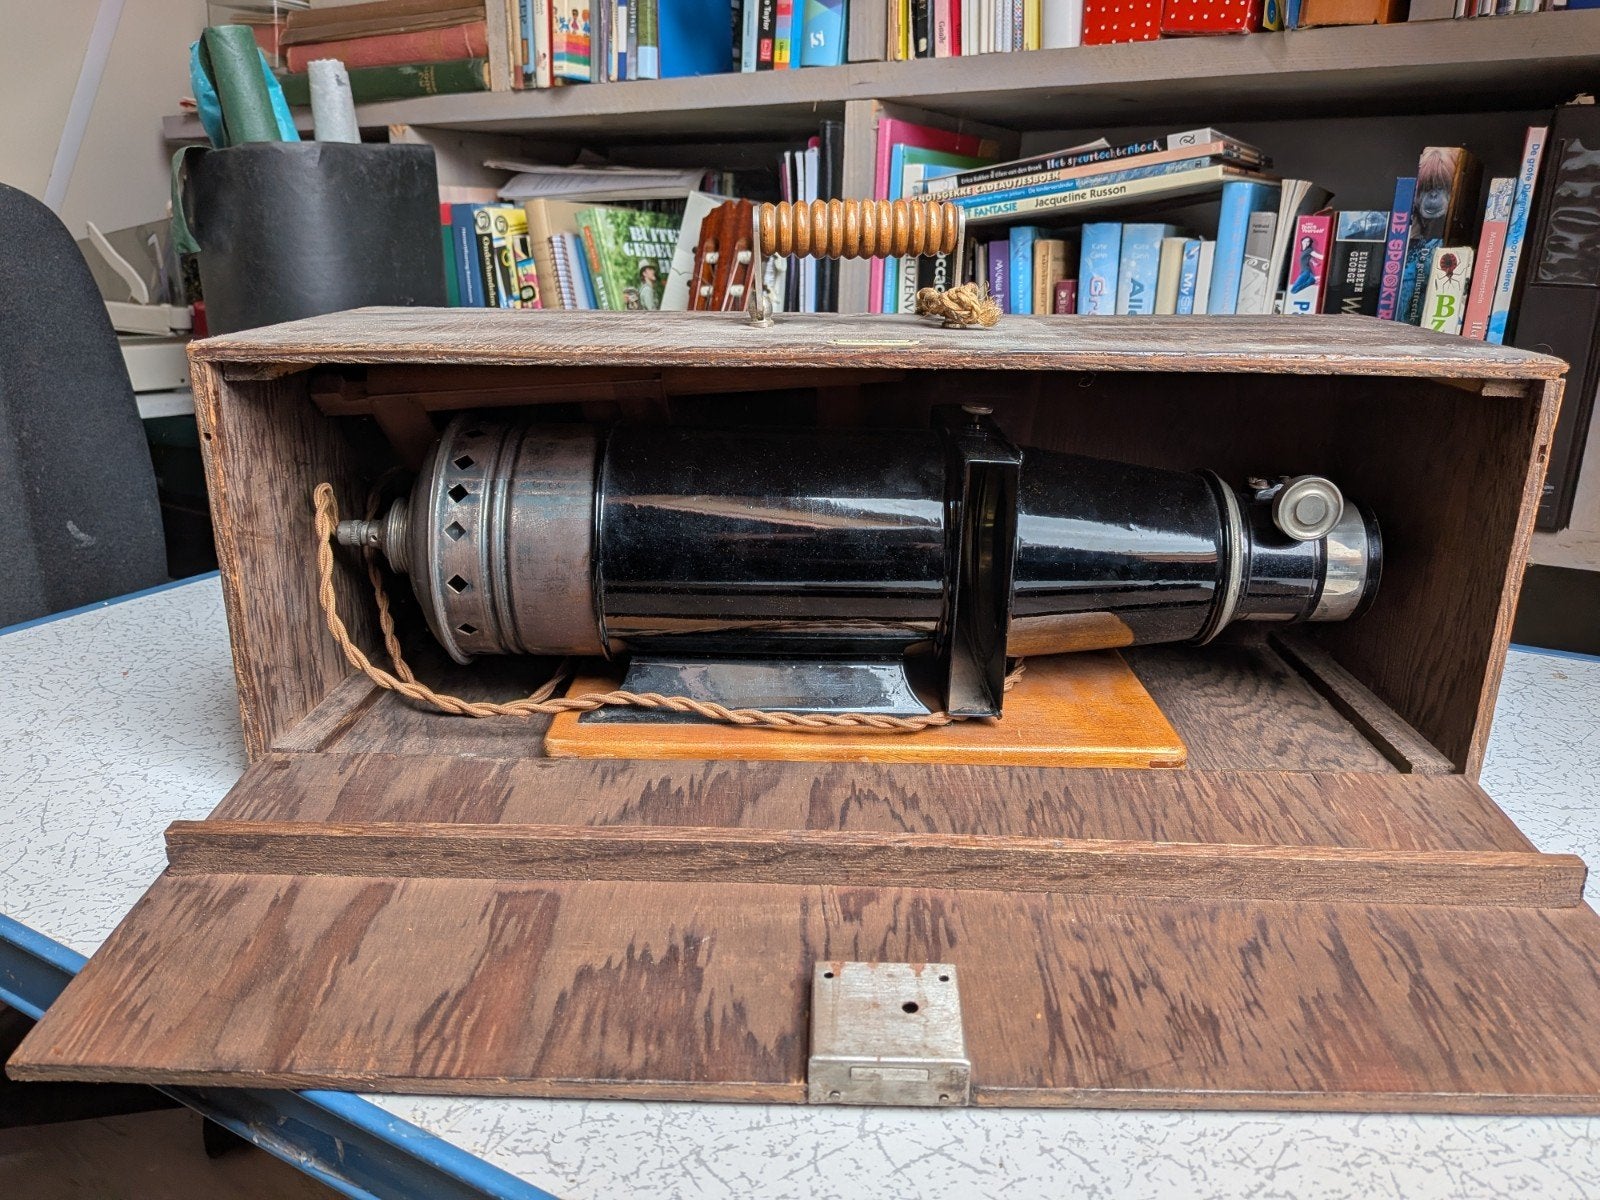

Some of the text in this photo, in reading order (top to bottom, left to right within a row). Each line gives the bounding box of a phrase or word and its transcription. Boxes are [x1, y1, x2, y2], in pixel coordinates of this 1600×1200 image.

[763, 3, 772, 30] Taylor
[1531, 143, 1540, 156] De
[1525, 158, 1536, 182] grote
[975, 171, 1061, 195] CADEAUTJESBOEK
[974, 202, 1017, 218] FANTASIE
[1035, 192, 1087, 208] Jacqueline
[1090, 184, 1127, 199] Russon
[1391, 212, 1408, 234] DE
[1346, 252, 1359, 284] GEORGE
[1354, 251, 1369, 293] ELIZABETH
[1503, 254, 1517, 292] kinderen
[904, 257, 915, 313] EUZENV
[1181, 273, 1194, 296] My
[1432, 294, 1456, 318] B
